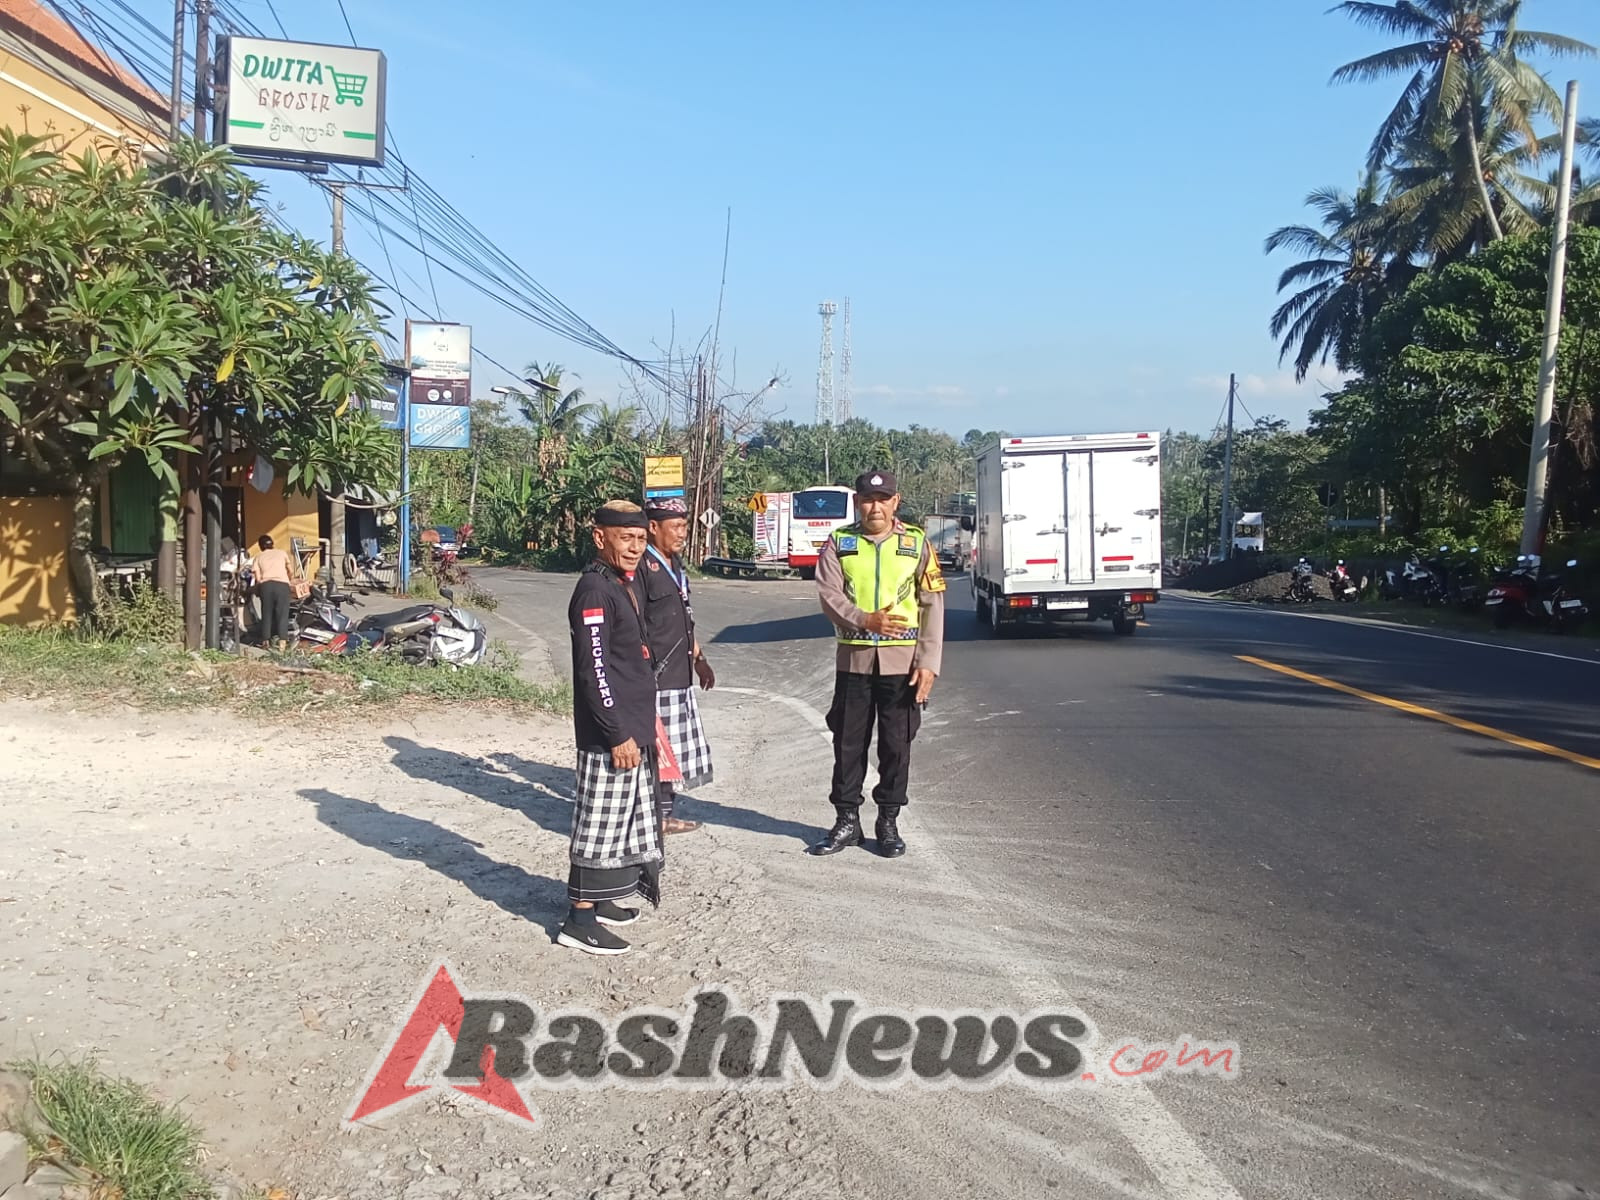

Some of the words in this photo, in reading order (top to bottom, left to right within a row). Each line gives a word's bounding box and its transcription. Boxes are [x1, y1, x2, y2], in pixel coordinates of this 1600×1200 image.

[243, 54, 324, 85] DWITA
[258, 87, 331, 112] GROSIR
[417, 407, 461, 420] DWITA
[590, 626, 615, 708] PECALANG
